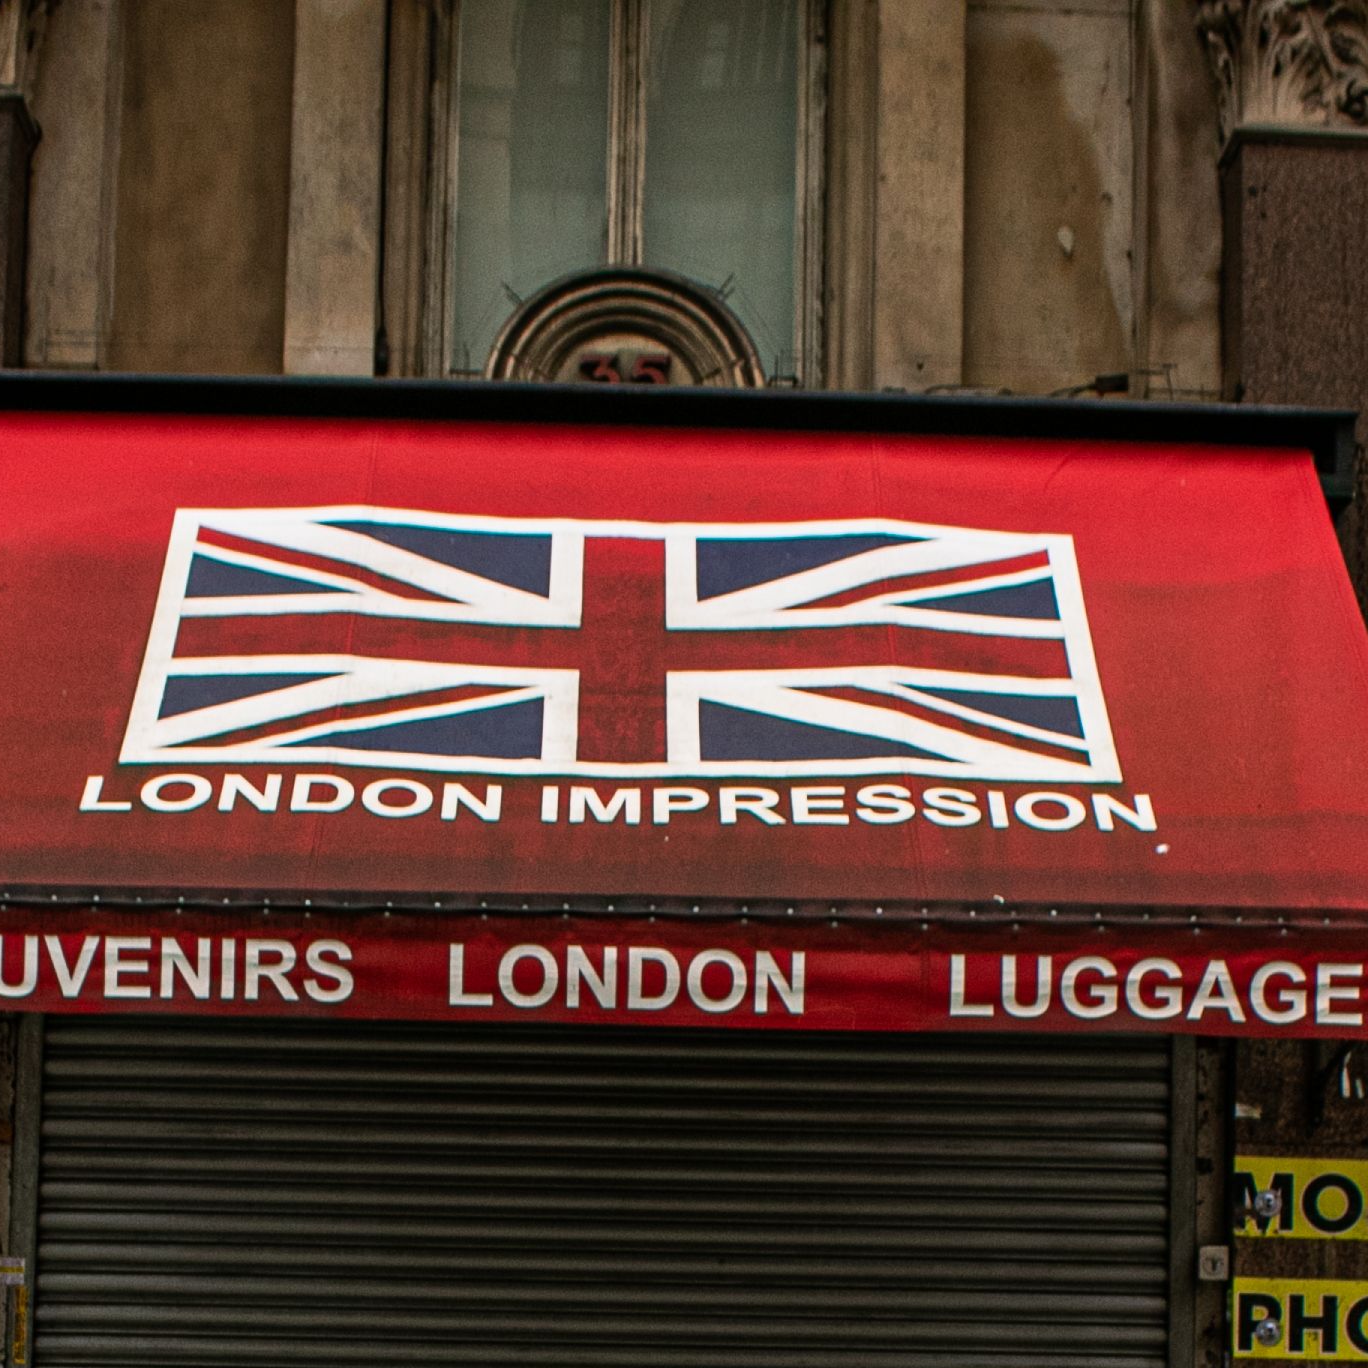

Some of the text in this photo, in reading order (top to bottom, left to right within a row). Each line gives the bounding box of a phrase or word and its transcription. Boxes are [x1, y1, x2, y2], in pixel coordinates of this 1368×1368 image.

[78, 771, 1159, 833] LONDON IMPRESSION
[447, 941, 807, 1017] LONDON
[948, 952, 1367, 1028] LUGGAGE
